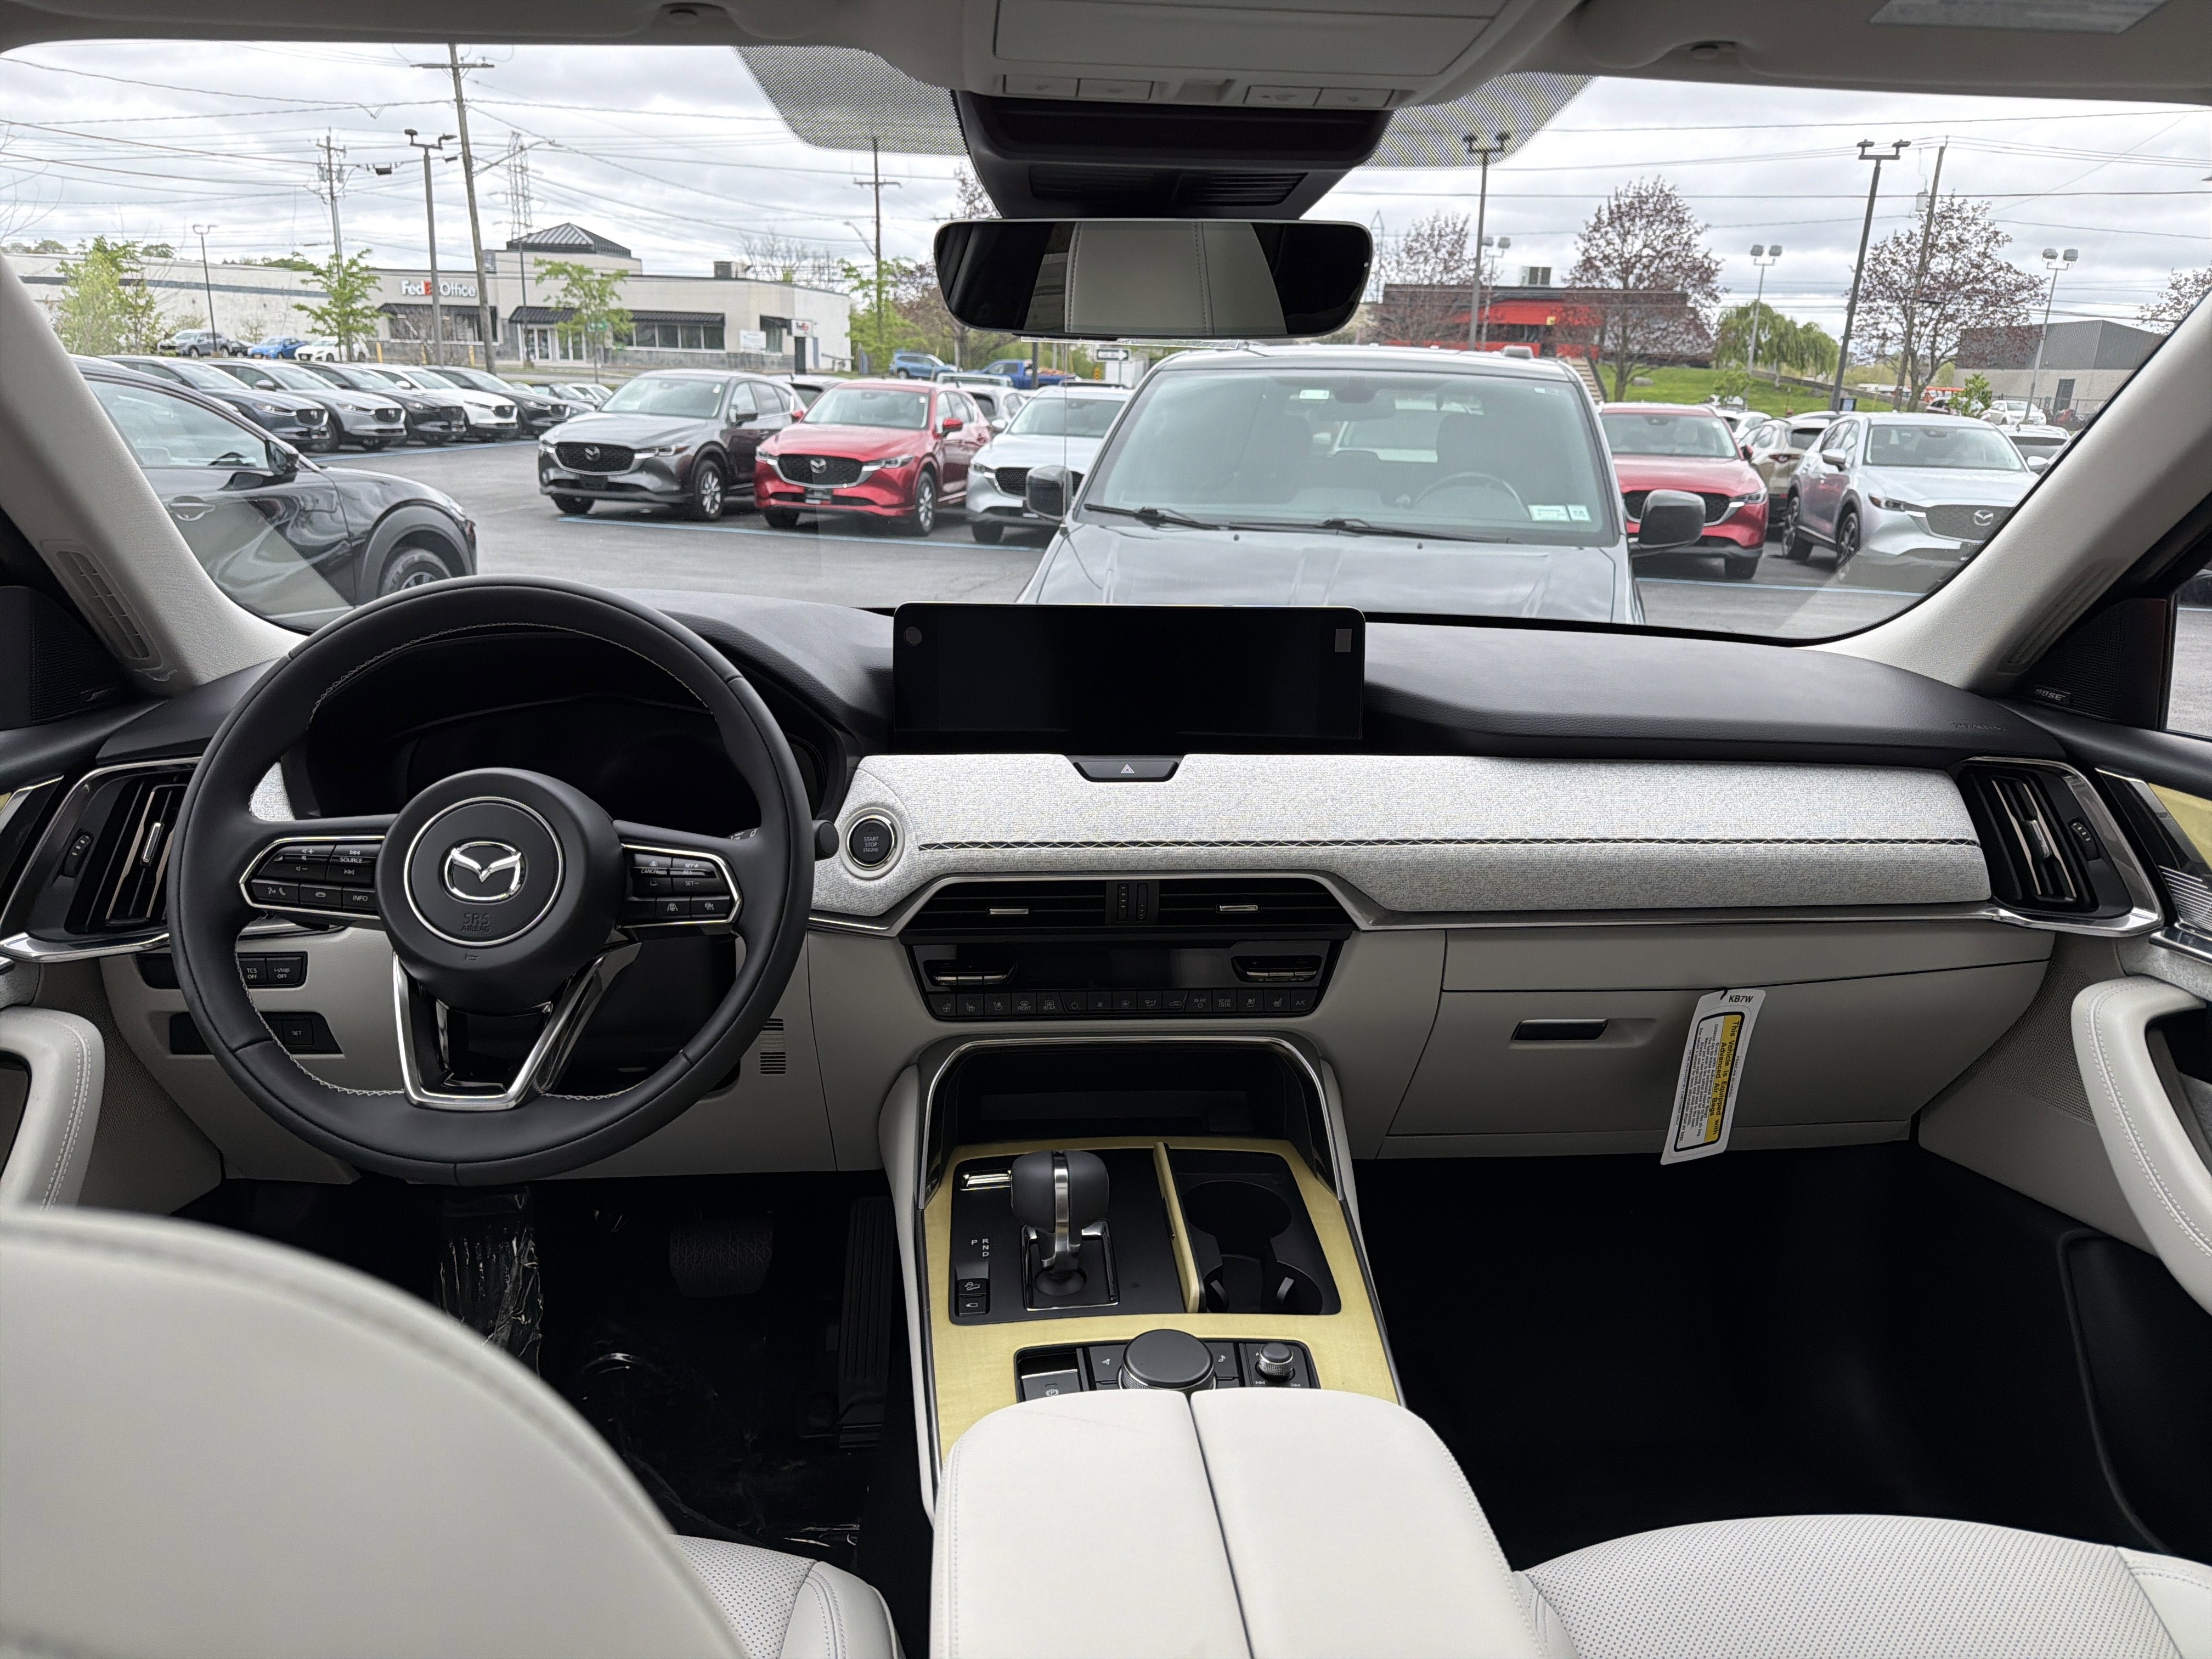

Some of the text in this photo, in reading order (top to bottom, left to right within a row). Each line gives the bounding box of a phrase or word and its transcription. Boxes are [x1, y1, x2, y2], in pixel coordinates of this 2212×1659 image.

[402, 280, 476, 296] FedE Office
[462, 912, 490, 926] SRS
[1729, 995, 1753, 1003] KB7W
[1729, 1020, 1739, 1037] This
[1716, 1041, 1727, 1079] Advanced
[1724, 1040, 1735, 1066] Vehicle
[1709, 1097, 1717, 1116] Bags
[1715, 1080, 1727, 1116] Equipped
